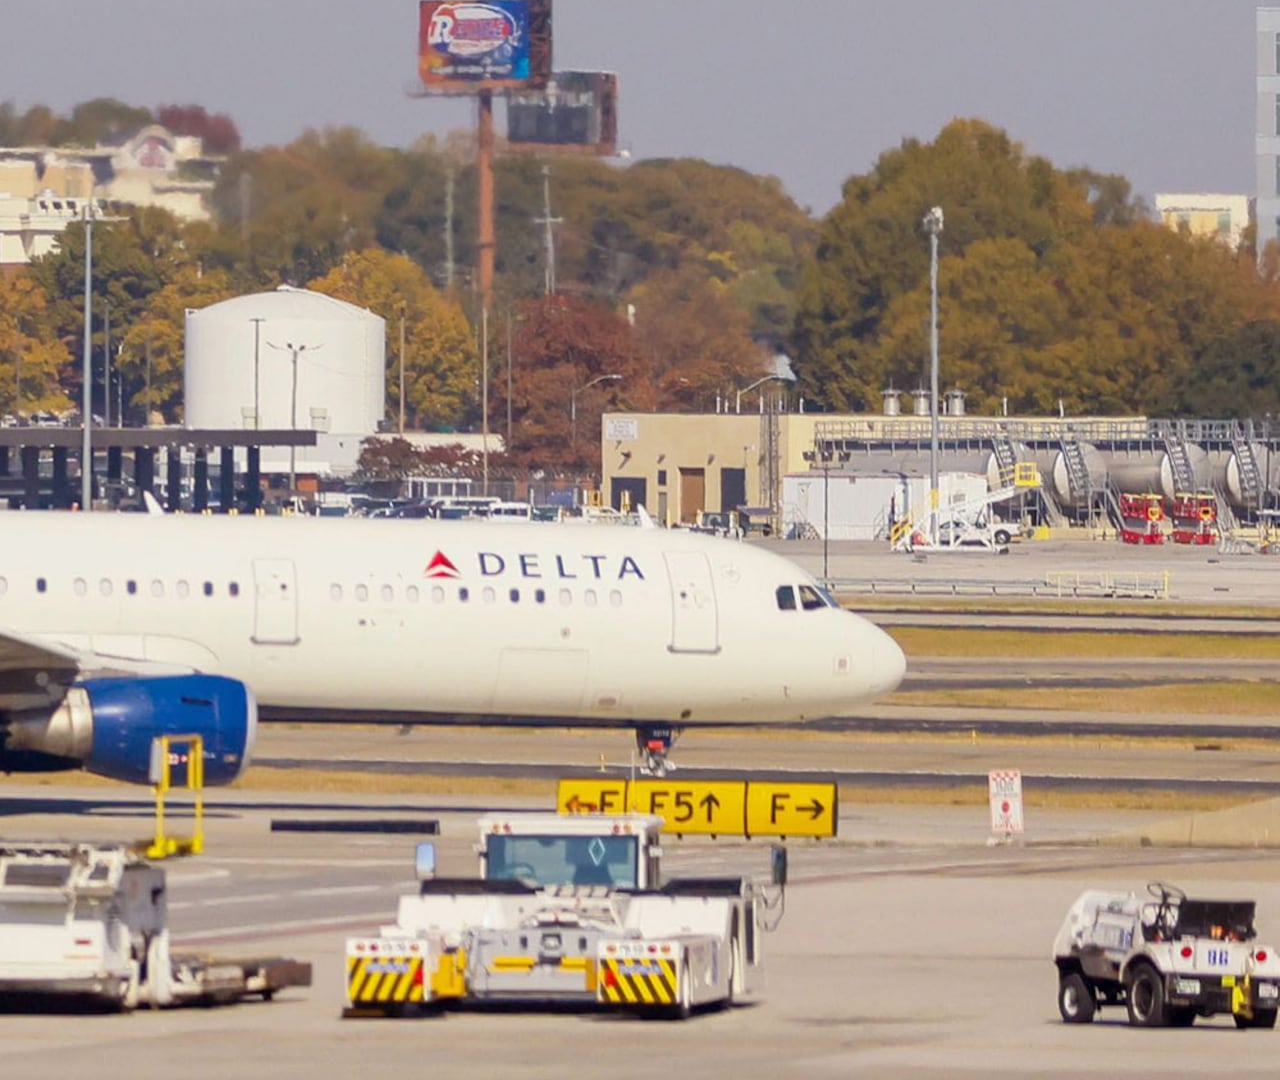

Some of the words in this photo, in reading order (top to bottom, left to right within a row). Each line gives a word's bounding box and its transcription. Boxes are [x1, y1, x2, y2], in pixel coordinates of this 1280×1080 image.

[478, 552, 645, 580] DELTA
[650, 792, 693, 822] F5
[771, 794, 790, 824] F
